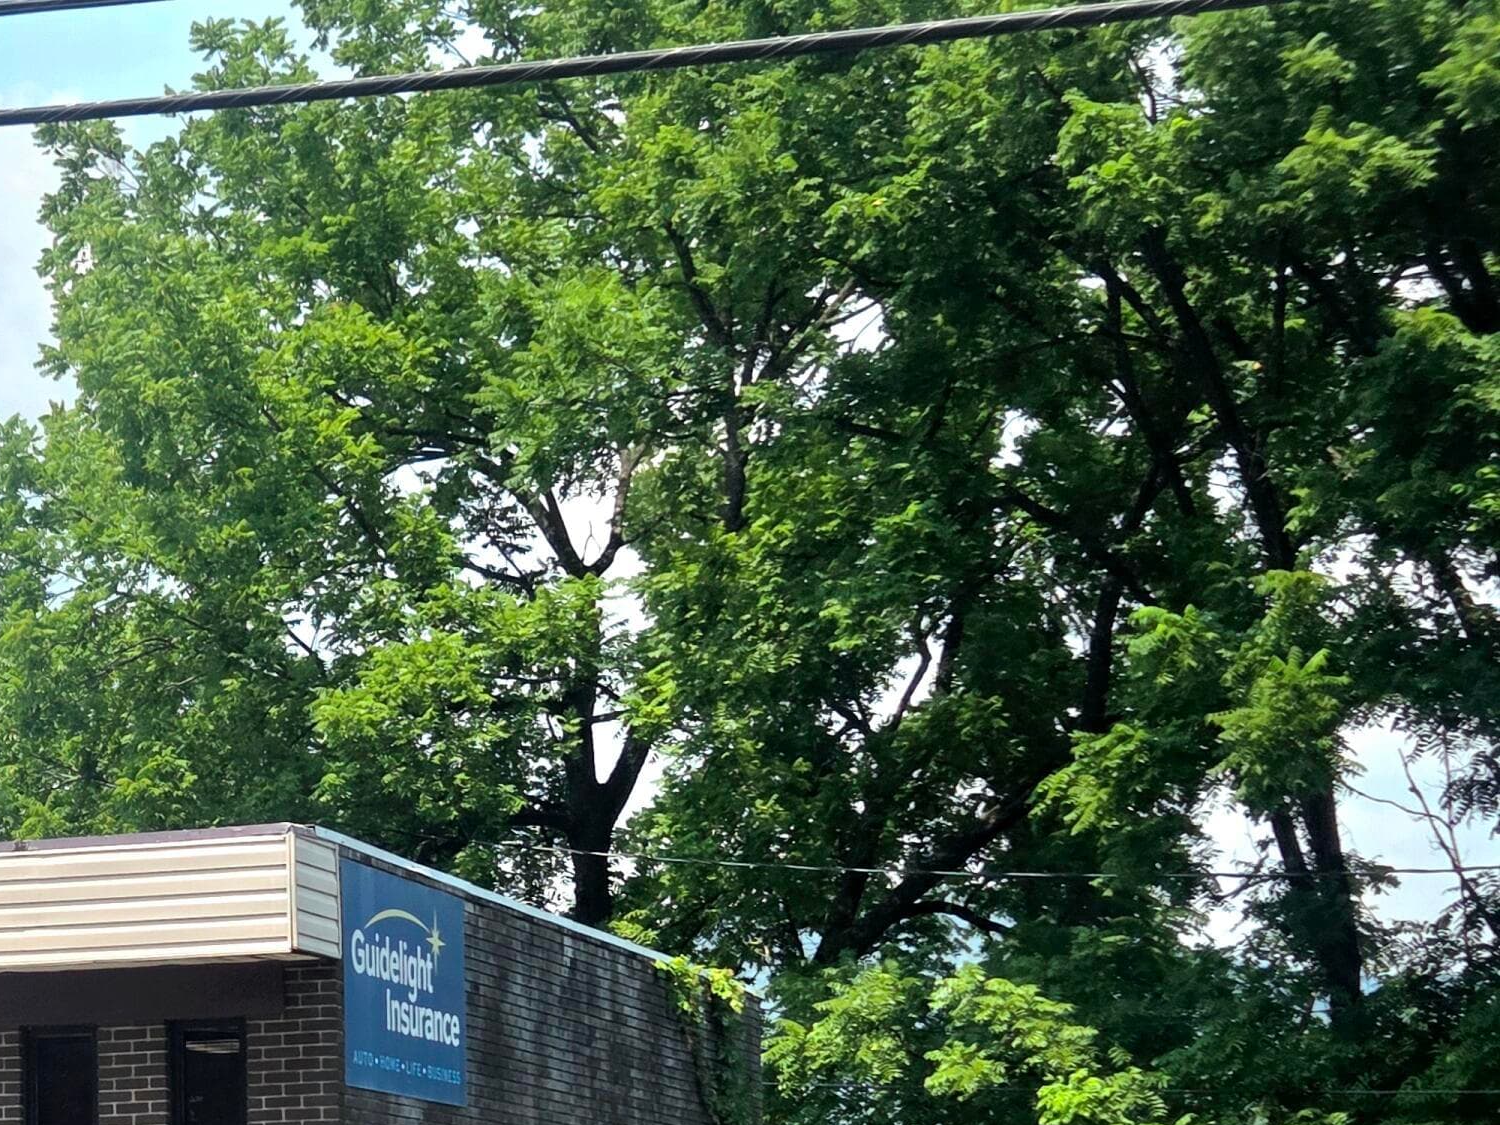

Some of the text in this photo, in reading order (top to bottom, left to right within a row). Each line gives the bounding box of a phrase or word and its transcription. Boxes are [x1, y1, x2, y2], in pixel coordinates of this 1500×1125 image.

[351, 929, 434, 1003] Guidelight
[386, 988, 460, 1047] Insurance
[353, 1049, 374, 1067] AUTO
[406, 1060, 422, 1077] LIFE
